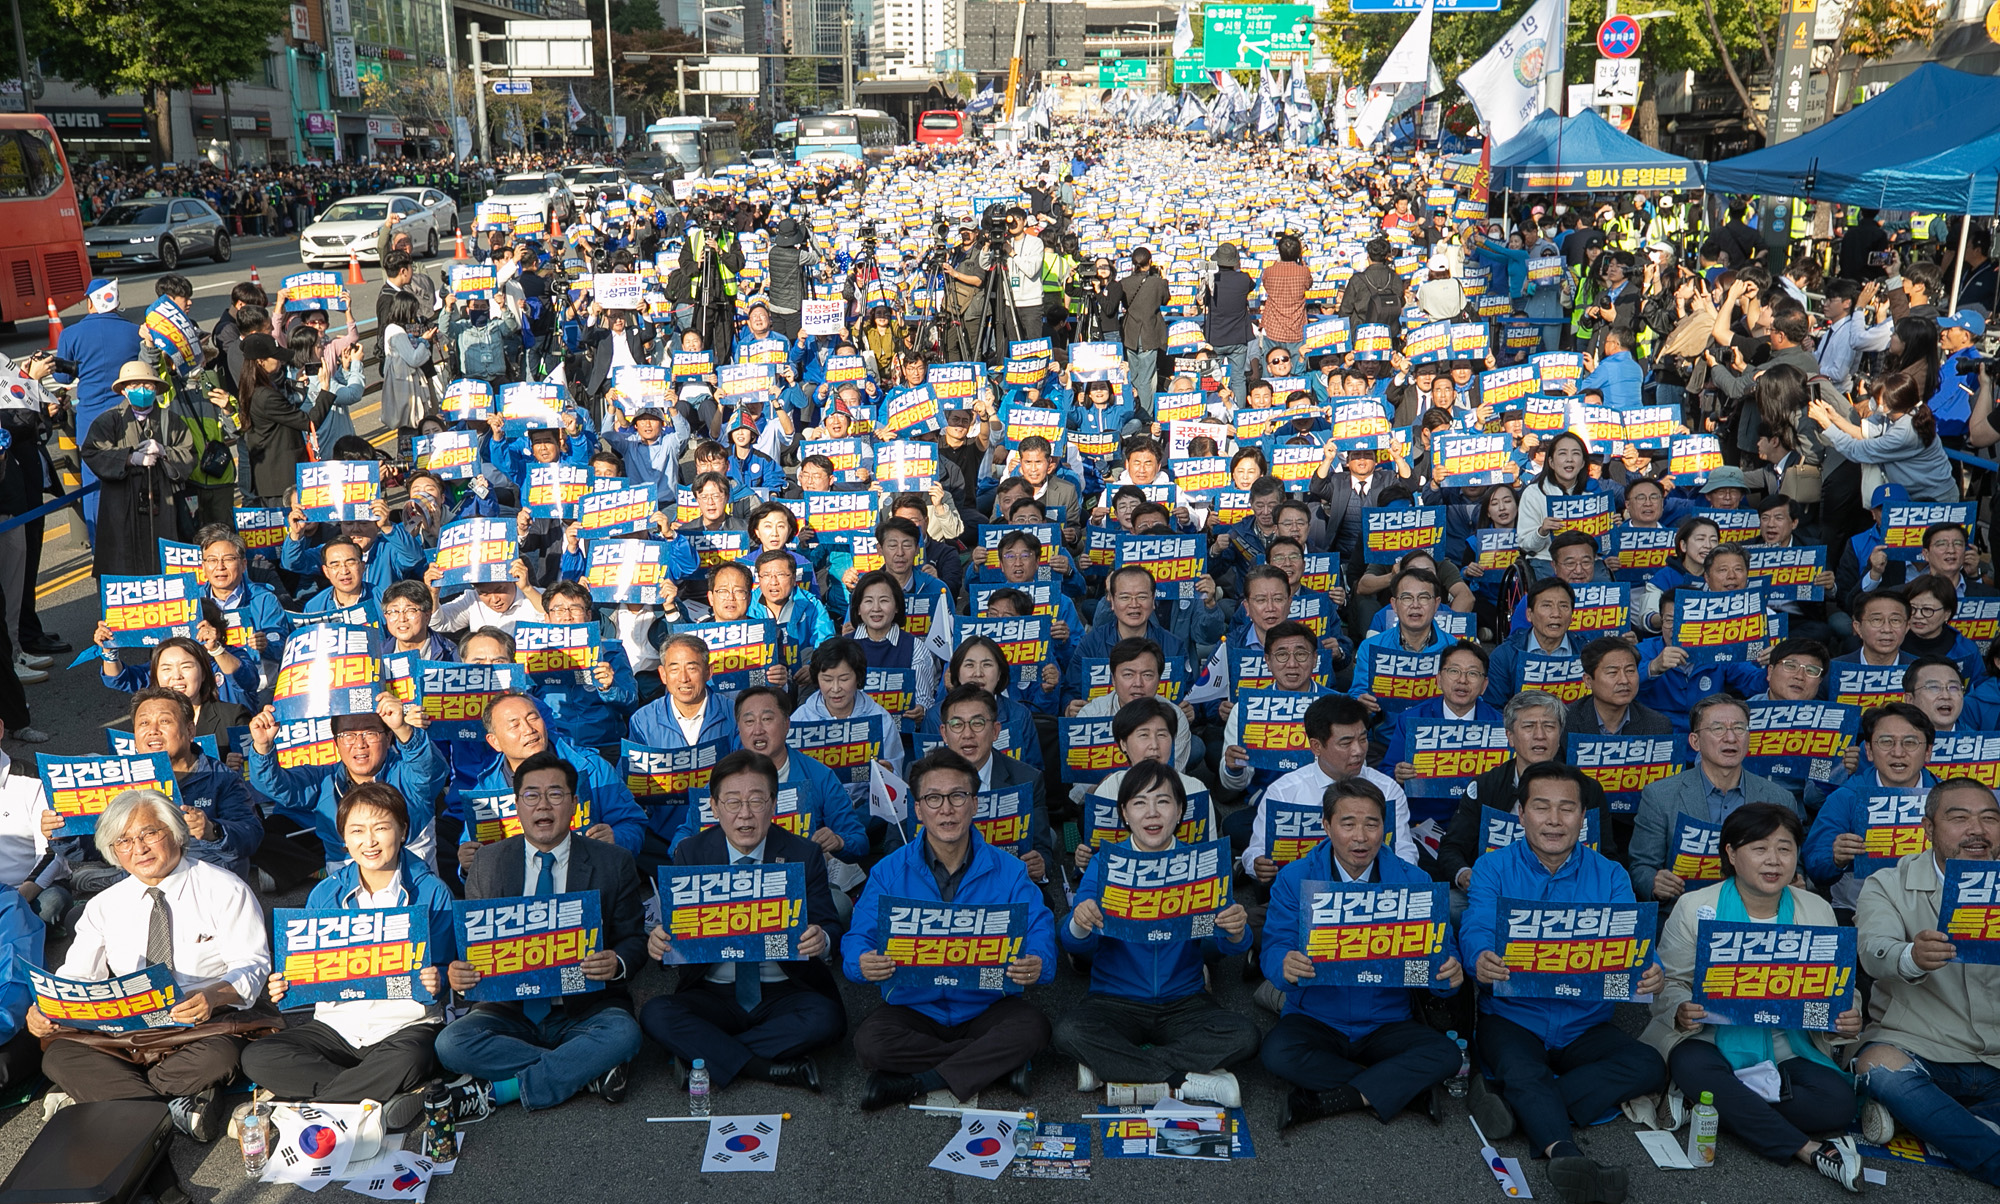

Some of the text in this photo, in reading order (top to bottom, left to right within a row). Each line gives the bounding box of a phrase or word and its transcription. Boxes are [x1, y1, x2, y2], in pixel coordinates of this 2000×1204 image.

[1603, 33, 1635, 41] 주정차금지
[1795, 21, 1807, 39] 4
[1787, 64, 1803, 112] 서울역
[311, 115, 322, 128] 약
[369, 121, 379, 132] 약
[1586, 169, 1619, 187] 행사
[1621, 167, 1687, 186] 운영본부
[804, 314, 843, 325] 진상규명!
[805, 303, 841, 315] 국정농단
[1306, 321, 1343, 337] 김건희를
[721, 366, 769, 381] 김건희를
[1483, 366, 1534, 391] 김건희를
[888, 388, 930, 416] 김건희를
[1157, 394, 1202, 408] 김건희를
[1483, 379, 1541, 405] 특검하라!
[1008, 409, 1060, 426] 김건희를
[1156, 405, 1206, 423] 특검하라!
[1335, 401, 1384, 420] 김건희를
[1067, 431, 1113, 444] 김건희를
[1445, 437, 1504, 455] 김건희를
[1273, 447, 1325, 465] 김건희를
[1444, 452, 1510, 474] 특검하라!
[301, 463, 369, 487] 김건희를
[1173, 460, 1226, 478] 김건희를
[300, 483, 378, 508] 특검하라!
[1175, 474, 1231, 492] 특검하라!
[584, 487, 649, 511] 김건희를
[809, 494, 870, 512] 김건희를
[1552, 496, 1609, 518] 김건희를
[235, 511, 285, 527] 김건희를
[582, 503, 656, 529] 특검하라!
[808, 511, 877, 531] 특검하라!
[1369, 511, 1436, 530] 김건희를
[1888, 506, 1967, 526] 김건희를
[440, 520, 507, 546] 김건희를
[1367, 527, 1443, 551] 특검하라!
[1619, 532, 1675, 550] 김건희
[1122, 538, 1197, 561] 김건희를
[106, 578, 184, 606] 김건희를
[105, 600, 197, 629] 특검하라!
[1683, 593, 1762, 621] 김건희를
[515, 624, 588, 649] 김건희를
[1677, 614, 1767, 645] 특검하라!
[1375, 653, 1439, 677] 김건희
[423, 666, 512, 692] 김건희를
[1749, 704, 1844, 729] 김건희를
[628, 743, 717, 773] 김건희를
[1577, 740, 1674, 766] 김건희를
[1930, 735, 2000, 762] 건희를
[47, 758, 156, 790] 김건희를
[1867, 796, 1925, 825] 김건
[1107, 848, 1219, 887] 김건희를
[670, 869, 787, 905] 김건희를
[1101, 875, 1229, 918] 특검하라!
[670, 899, 803, 936] 특검하라!
[1311, 888, 1433, 924] 김건희를
[286, 912, 411, 951] 김건희를
[464, 899, 583, 941] 김건희를
[889, 907, 1010, 935] 김건희를
[1508, 907, 1638, 938] 김건희를
[466, 928, 599, 975] 특검하라!
[885, 936, 1023, 965] 특검하라!
[1306, 922, 1446, 960] 특검하라!
[1709, 930, 1838, 962] 김건희를
[284, 942, 427, 982] 특검하라!
[1502, 939, 1651, 971] 특검하라!
[29, 971, 153, 1001] 김건희를
[1702, 965, 1852, 998] 특검하라!
[37, 985, 176, 1019] 특검하라!
